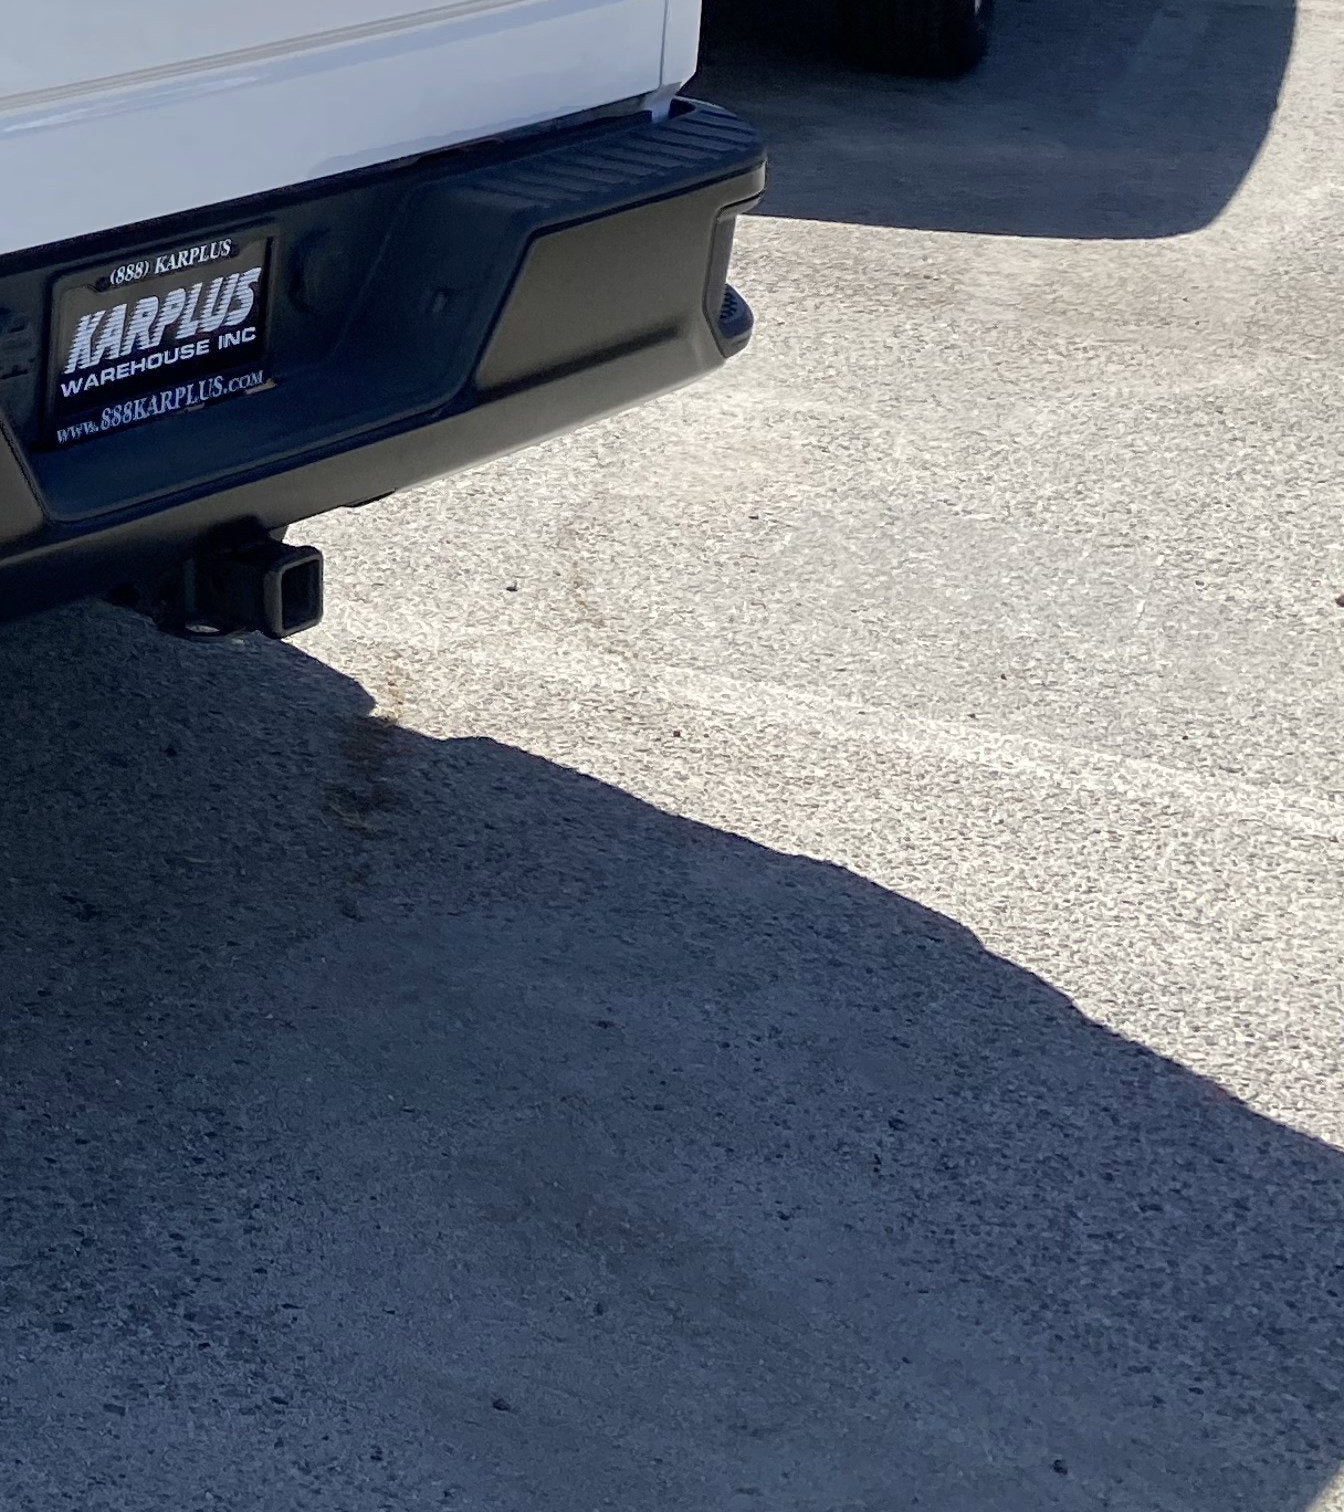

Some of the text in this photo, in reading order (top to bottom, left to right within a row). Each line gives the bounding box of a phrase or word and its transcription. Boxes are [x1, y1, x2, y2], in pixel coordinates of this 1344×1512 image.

[109, 239, 232, 286] (888) KARPLUS
[64, 267, 262, 374] KARPLUS
[60, 326, 257, 398] WAREHOUSE INC
